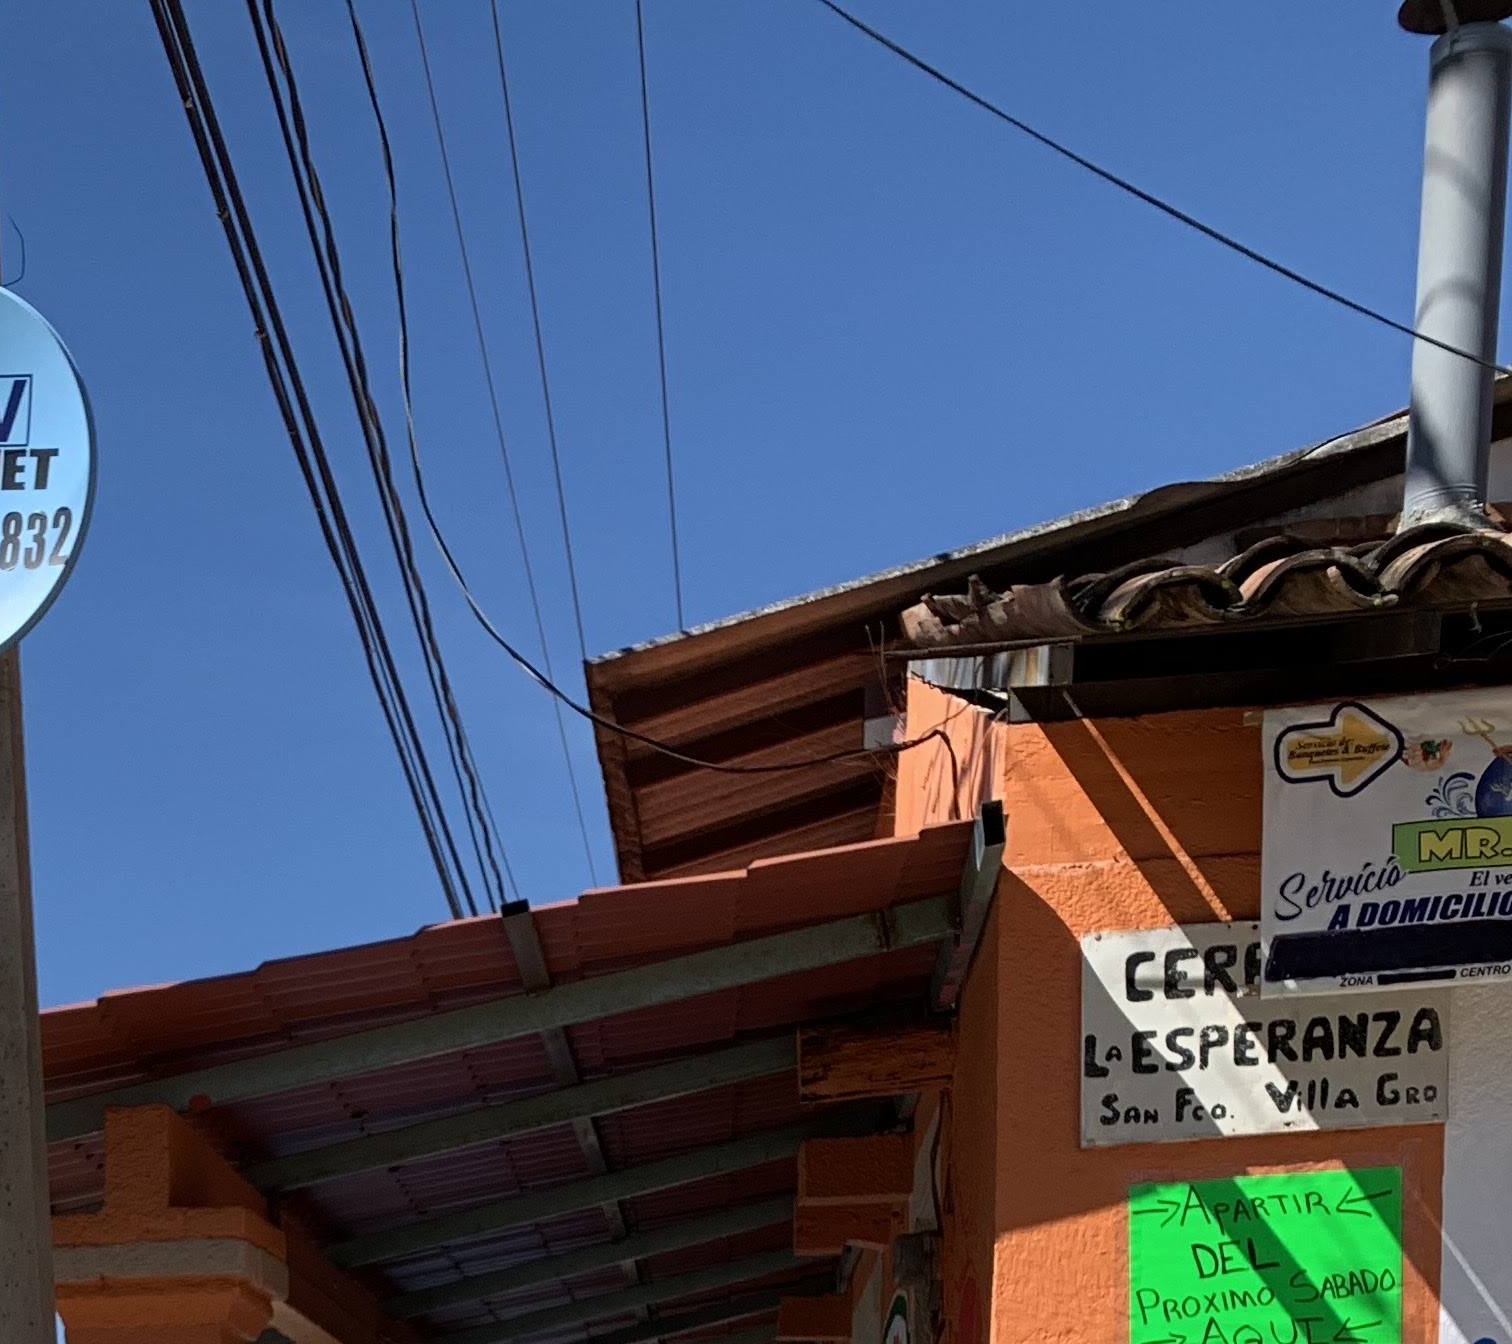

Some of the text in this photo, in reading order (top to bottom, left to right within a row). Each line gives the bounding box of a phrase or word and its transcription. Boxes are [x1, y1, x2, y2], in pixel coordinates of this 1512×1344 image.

[1274, 856, 1406, 921] Servicio
[1469, 870, 1491, 887] El
[1328, 903, 1351, 930] A
[1339, 974, 1374, 988] ZONA
[1460, 964, 1511, 978] CENTRO
[1131, 1007, 1443, 1075] ESPERANZA
[1191, 1238, 1280, 1279] DEL
[1136, 1268, 1396, 1325] PROXIMO SABADO
